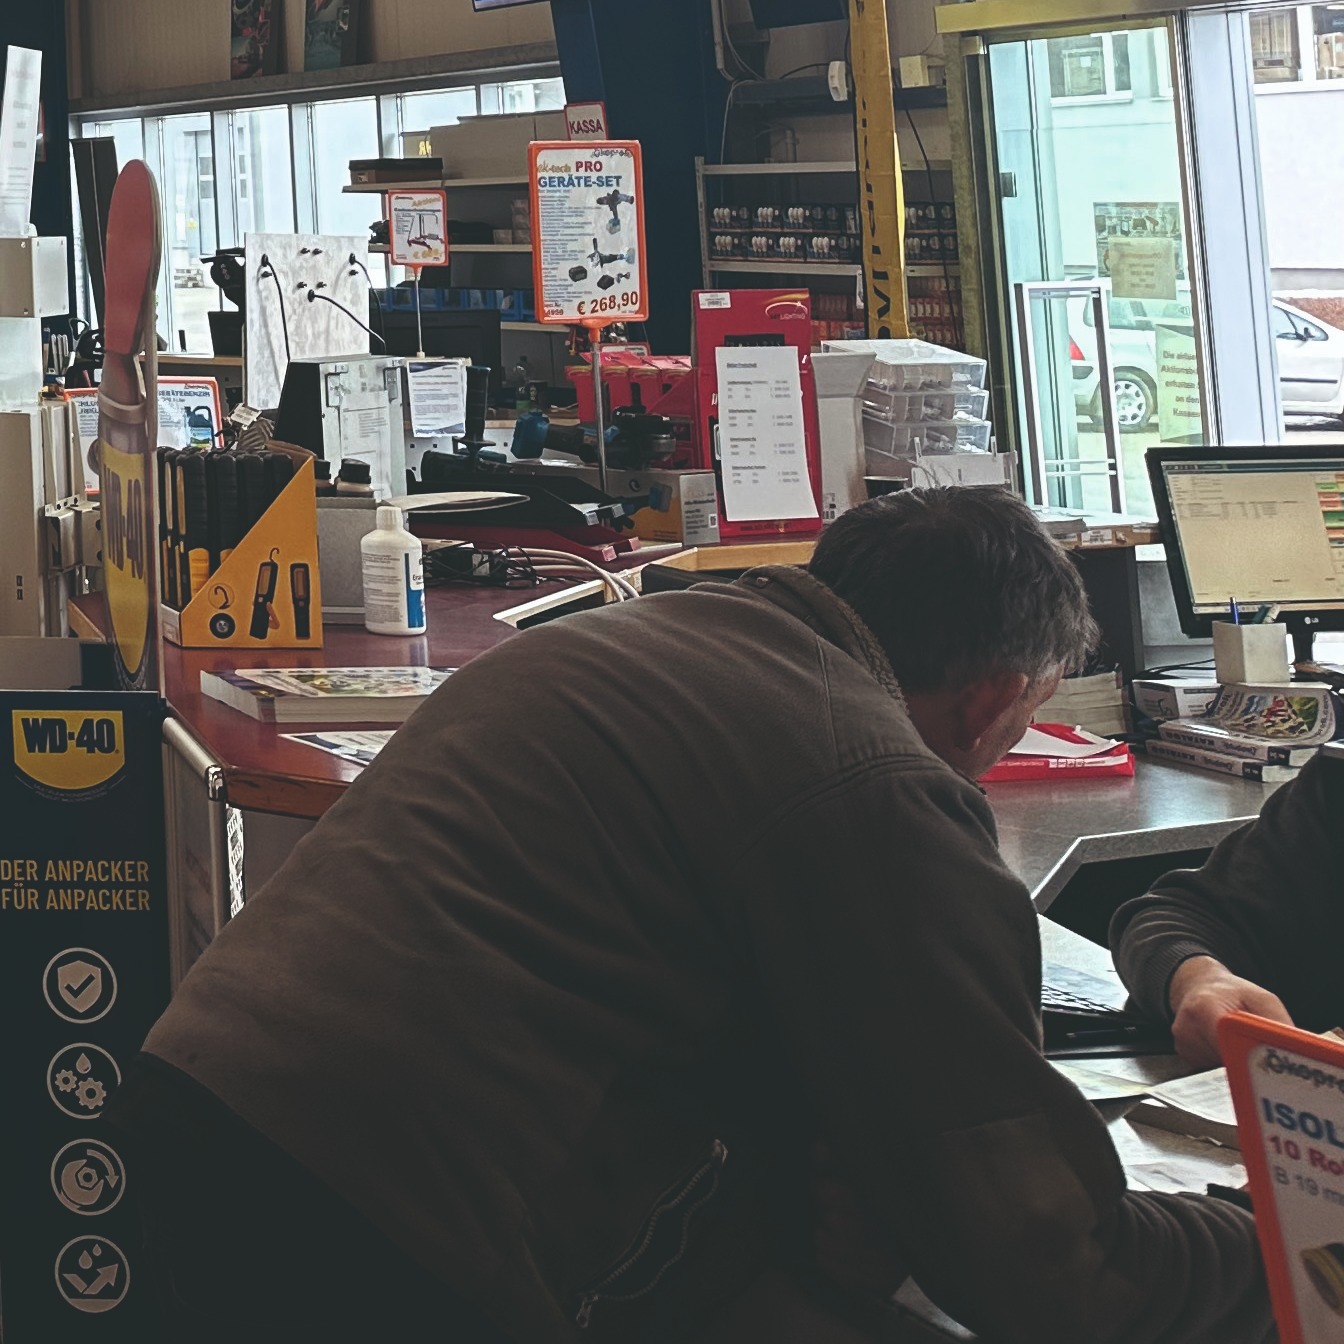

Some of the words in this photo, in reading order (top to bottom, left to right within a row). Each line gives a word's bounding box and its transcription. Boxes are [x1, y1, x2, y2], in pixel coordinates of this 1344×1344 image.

[568, 120, 604, 135] KASSA
[575, 161, 603, 172] PRO
[538, 174, 622, 188] GERÄTE-SET
[577, 301, 586, 315] €
[590, 291, 639, 314] 268,90
[21, 718, 116, 754] WD-40
[0, 860, 38, 881] DER
[45, 860, 150, 882] ANPACKER
[1, 882, 39, 910] FÜR
[46, 889, 151, 911] ANPACKER
[1268, 1136, 1301, 1162] 10
